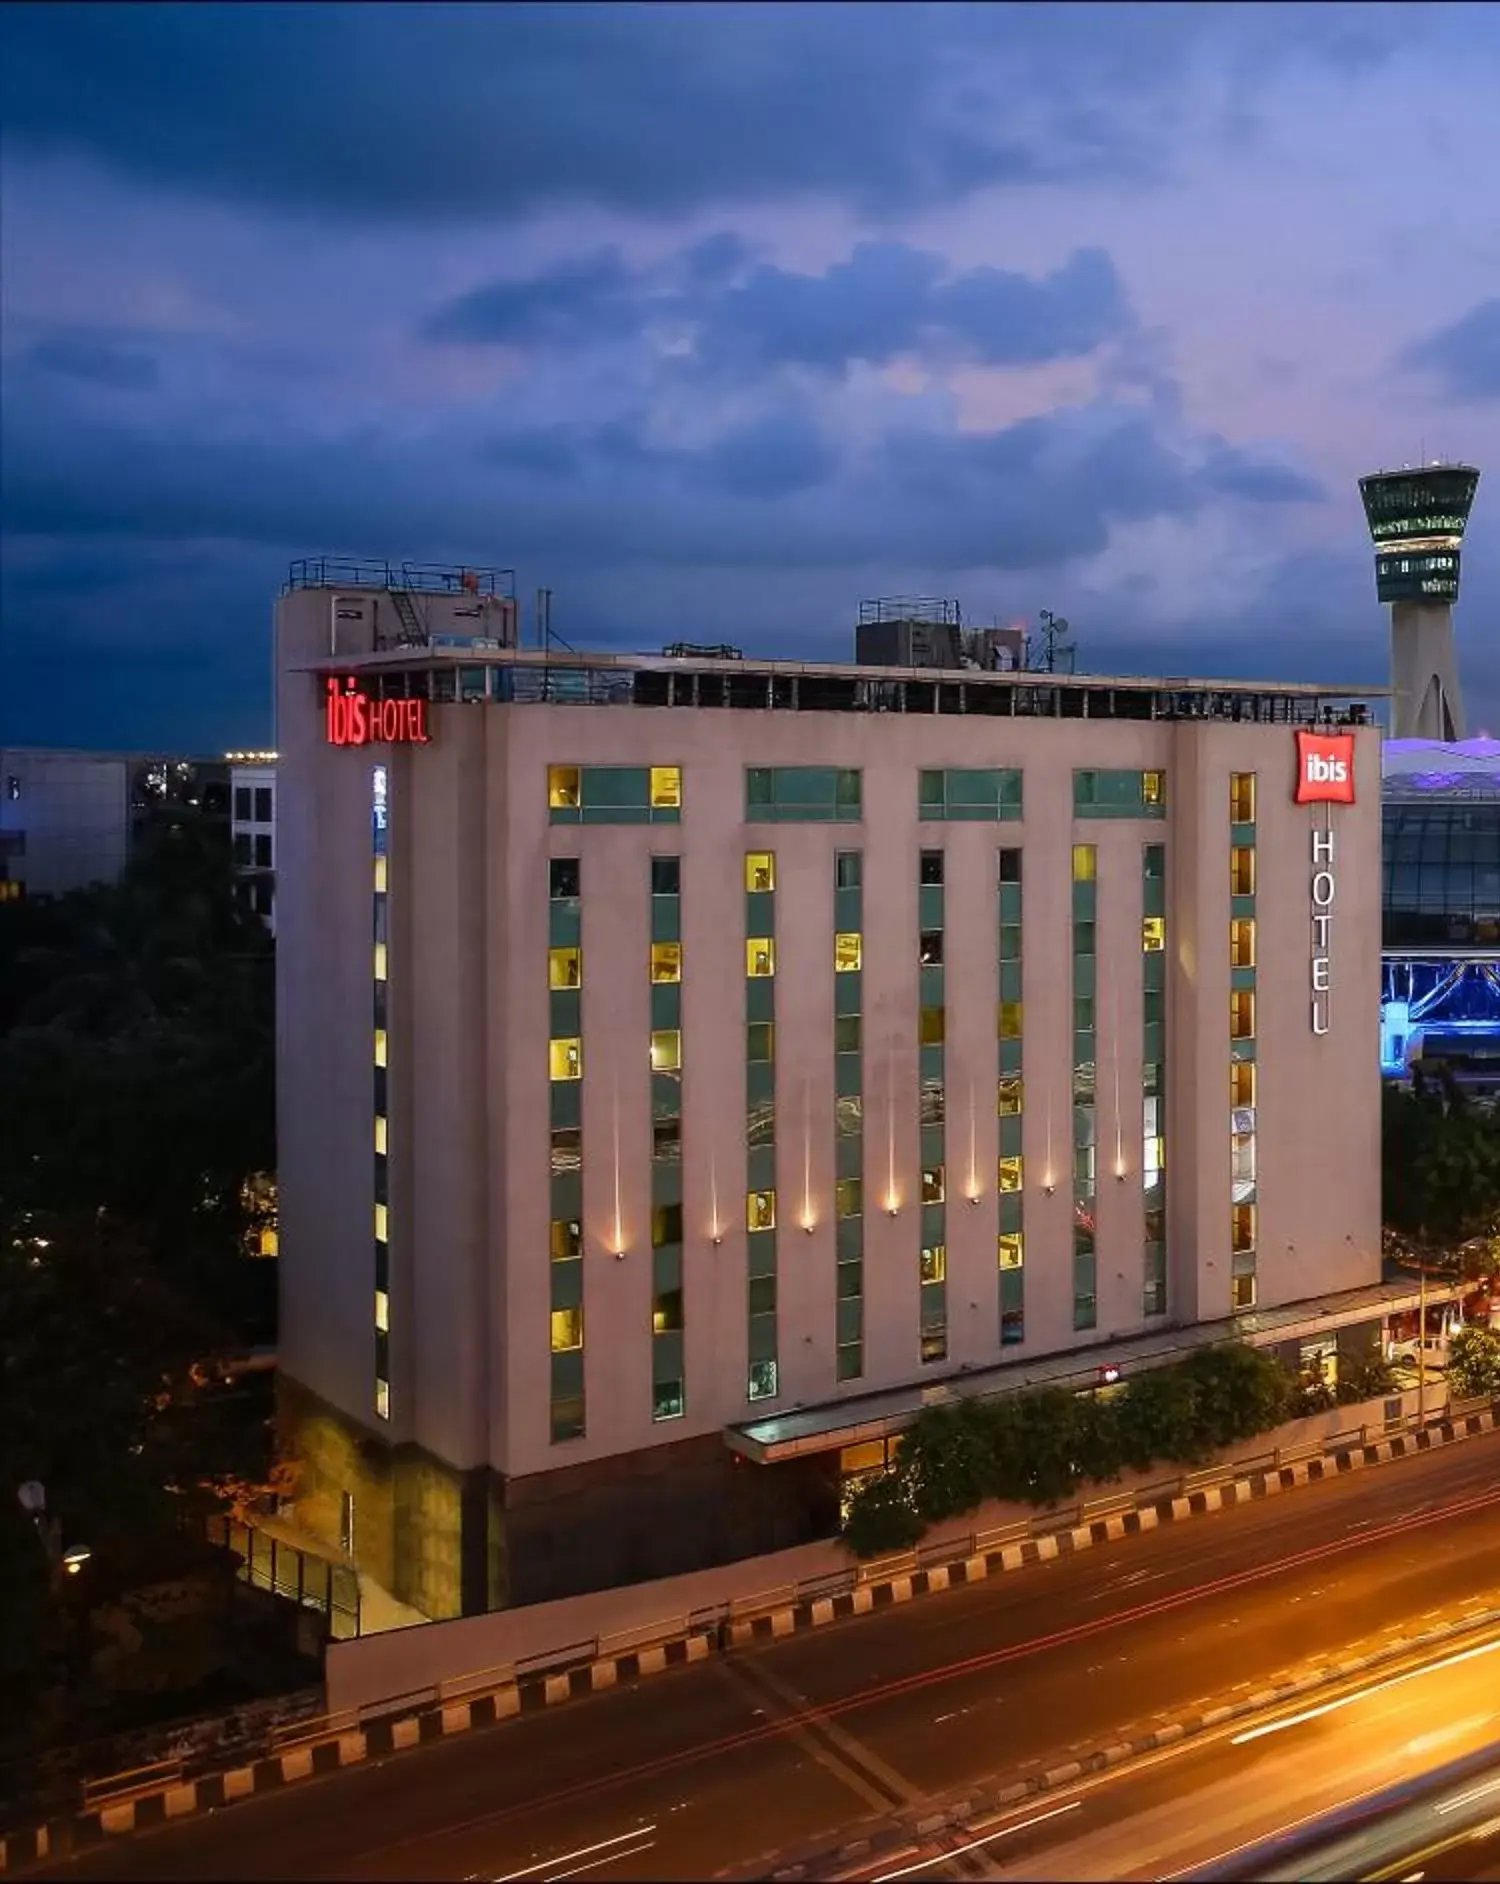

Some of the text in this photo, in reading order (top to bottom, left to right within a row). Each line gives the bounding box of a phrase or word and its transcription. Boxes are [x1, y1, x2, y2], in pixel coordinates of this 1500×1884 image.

[327, 677, 427, 744] ibis HOTEL
[1307, 753, 1347, 782] ibis
[1311, 831, 1335, 1035] HOTEL
